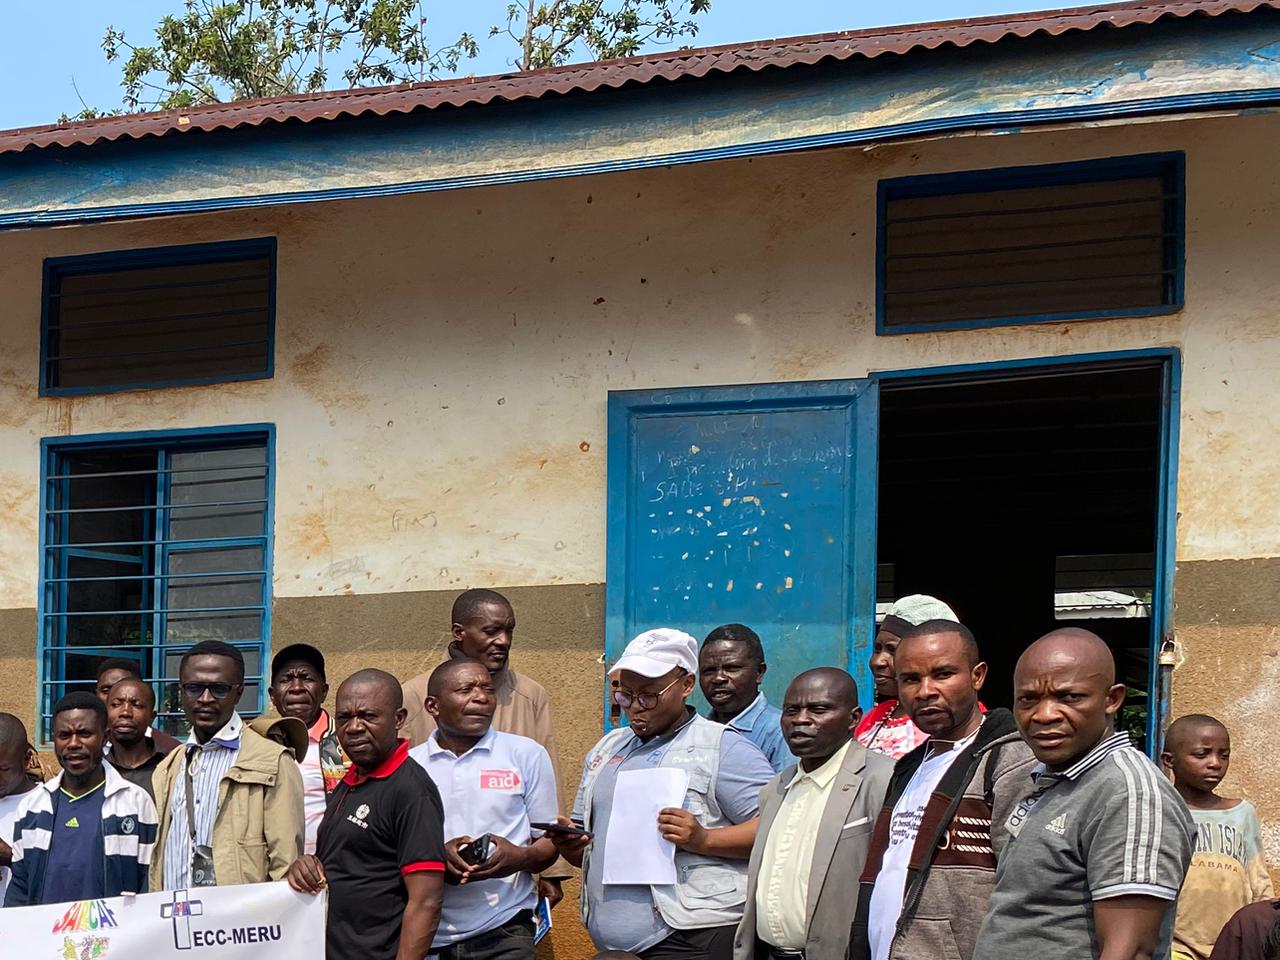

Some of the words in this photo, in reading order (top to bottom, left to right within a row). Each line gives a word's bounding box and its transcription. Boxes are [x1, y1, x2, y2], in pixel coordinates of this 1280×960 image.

[488, 773, 514, 787] aid
[1010, 784, 1048, 827] adid
[1190, 860, 1238, 873] LABAMA
[193, 924, 282, 947] ECC-MERU
